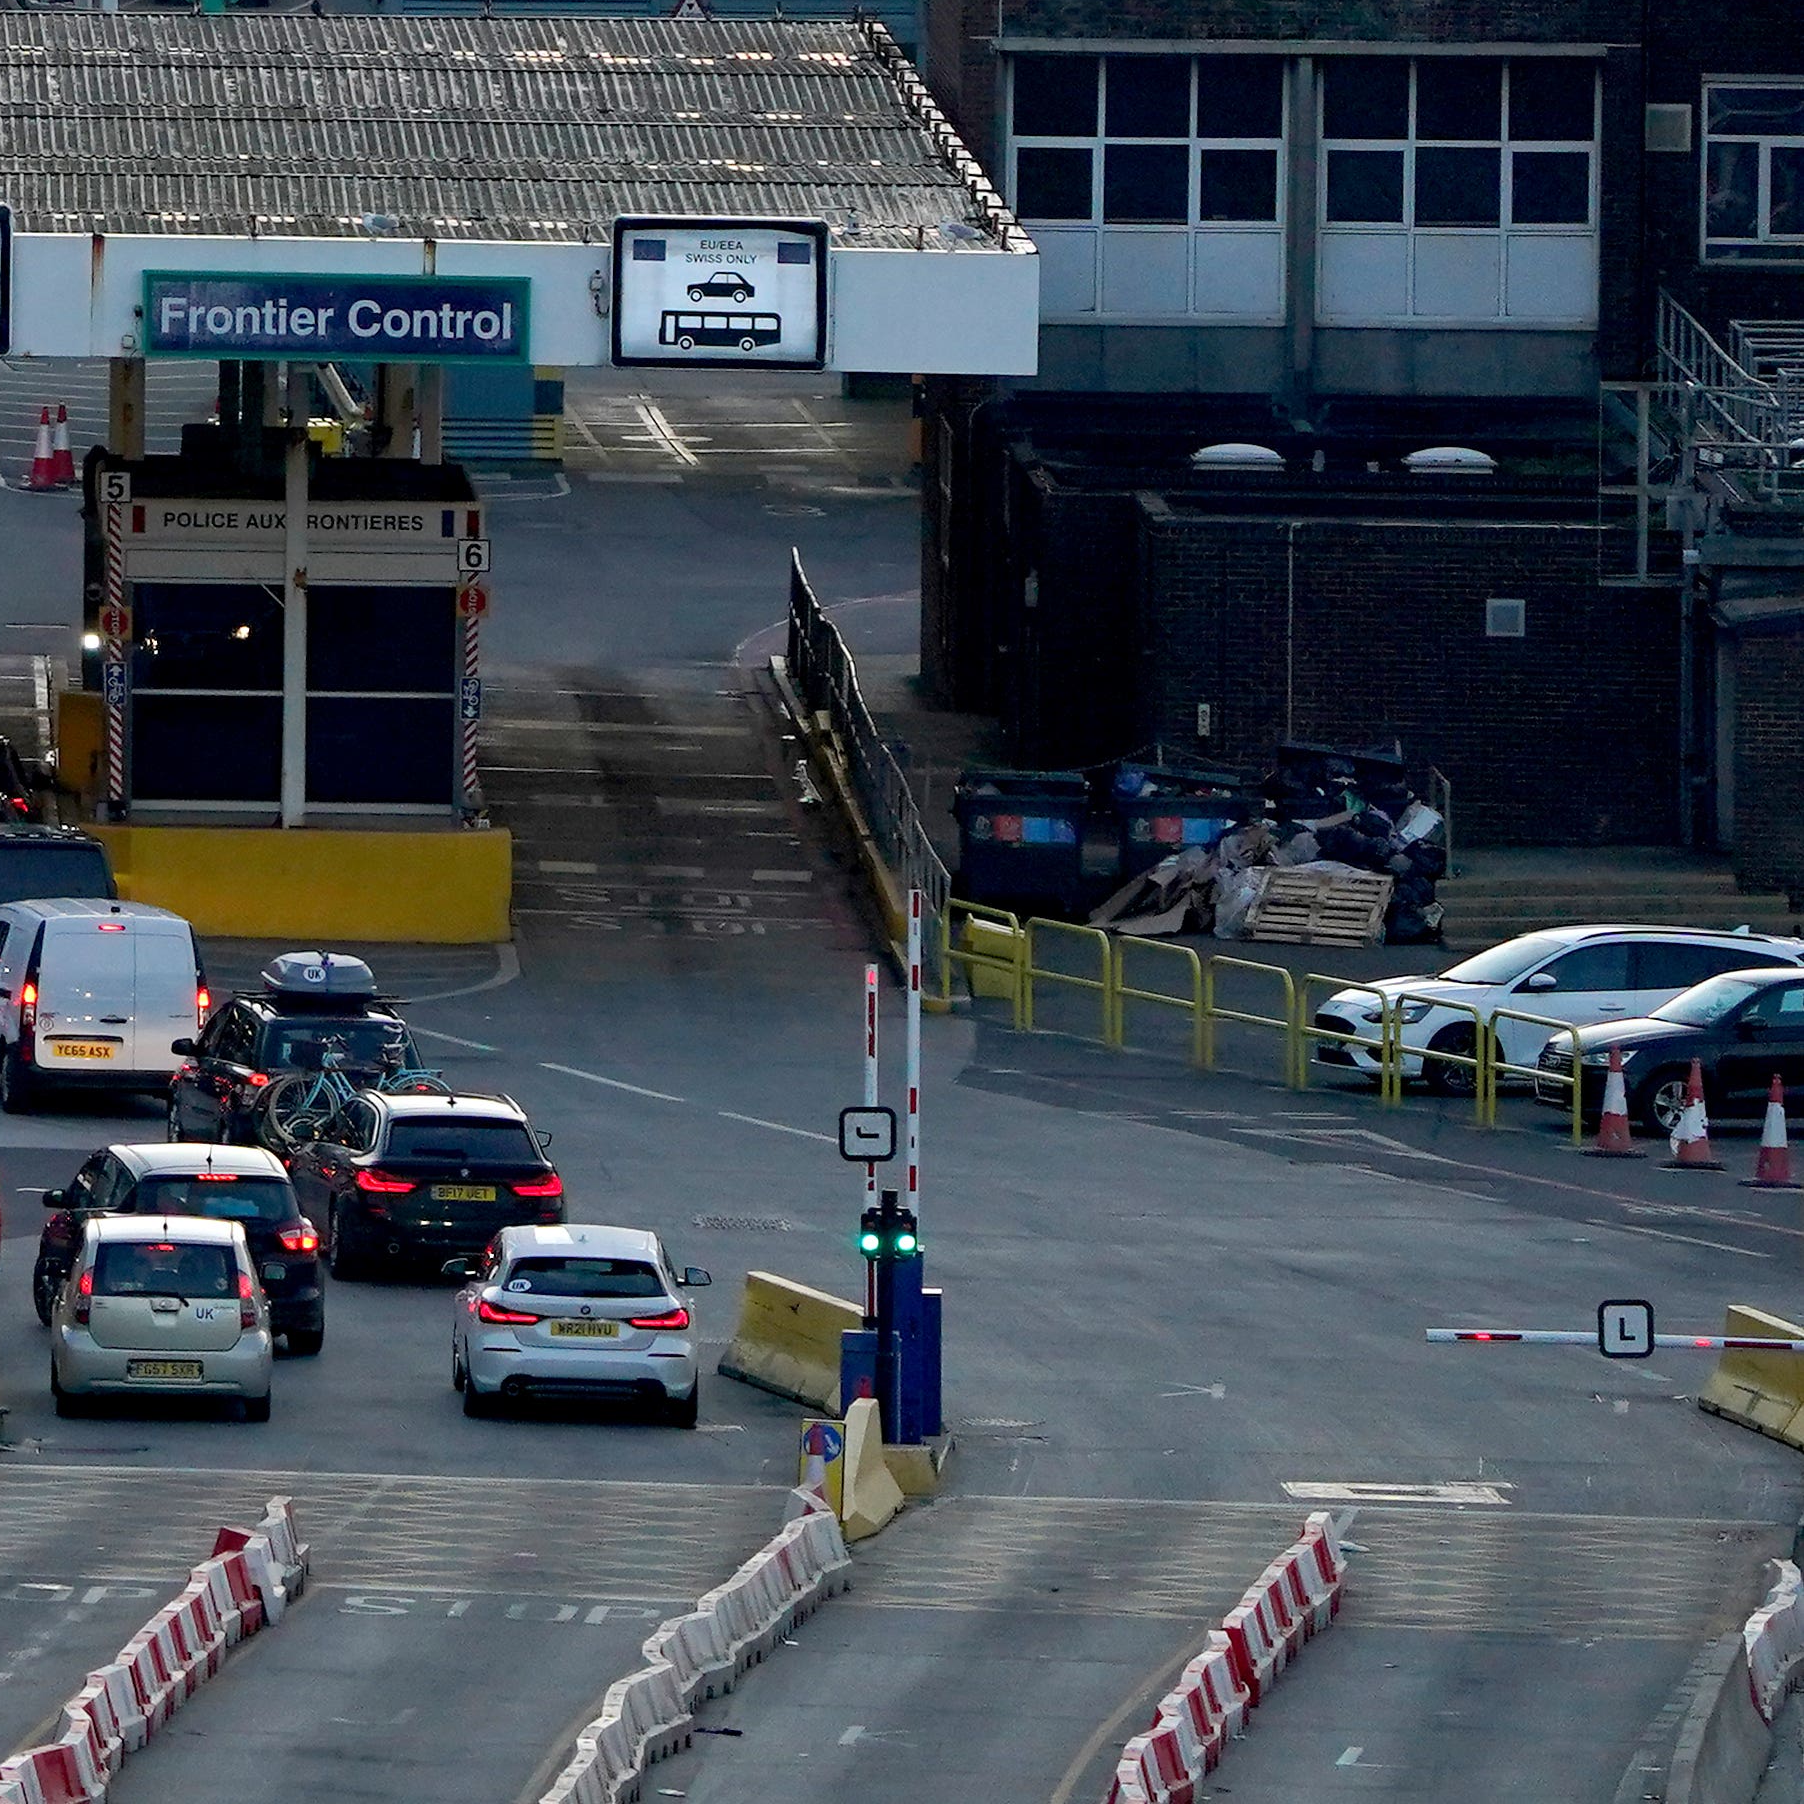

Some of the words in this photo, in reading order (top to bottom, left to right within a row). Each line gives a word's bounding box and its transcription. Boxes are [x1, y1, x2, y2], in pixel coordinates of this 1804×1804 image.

[699, 239, 745, 252] EU/EEA
[685, 253, 723, 264] SWISS
[726, 253, 757, 265] ONLY
[160, 297, 329, 337] Frontier
[345, 300, 514, 342] Control
[107, 475, 125, 499] 5
[164, 512, 239, 529] POLICE
[306, 514, 424, 532] RONTIERES
[464, 542, 483, 568] 6
[307, 969, 321, 979] UK
[89, 1047, 111, 1058] ASX
[511, 1281, 526, 1291] UK
[195, 1307, 214, 1320] UK
[1618, 1317, 1636, 1342] L
